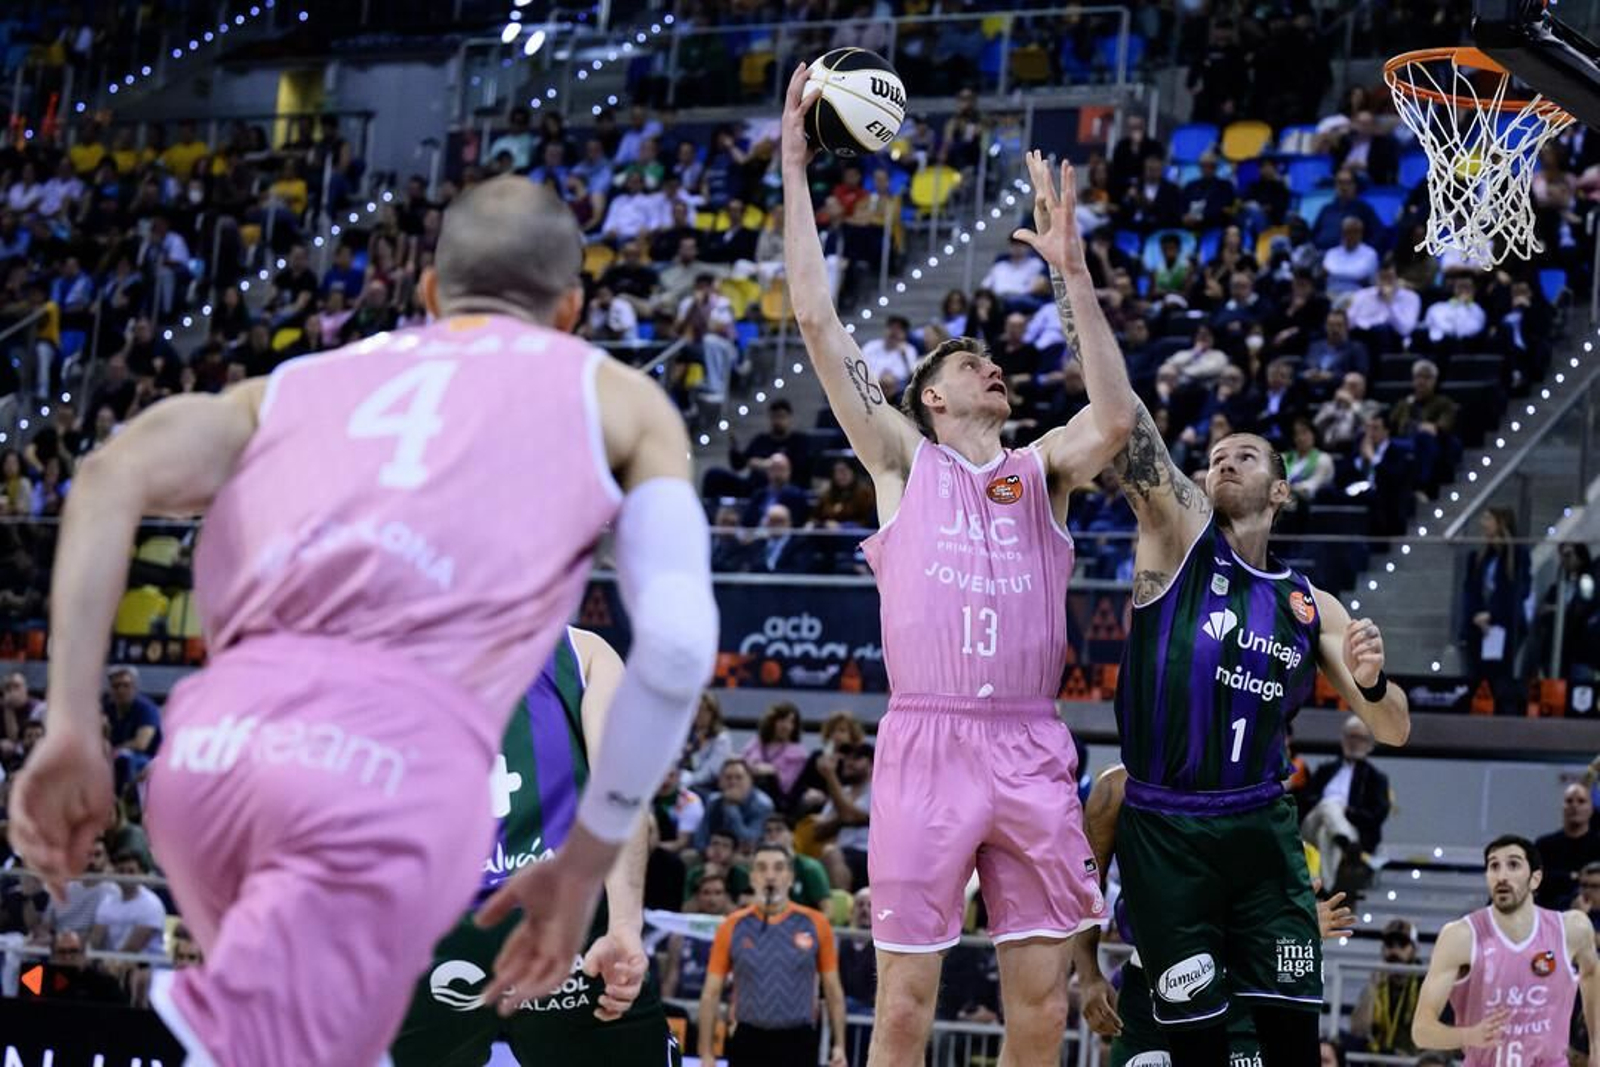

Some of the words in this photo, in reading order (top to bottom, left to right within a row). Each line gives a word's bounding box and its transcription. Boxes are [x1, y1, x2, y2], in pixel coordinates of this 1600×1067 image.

[870, 76, 906, 112] Wils
[347, 359, 458, 488] 4
[940, 509, 1018, 546] J&C
[924, 562, 1032, 596] JOVENTUT
[763, 612, 823, 641] acb
[962, 605, 998, 657] 13
[1236, 628, 1301, 669] Unicaja
[1215, 665, 1284, 701] málaga
[1230, 717, 1247, 763] 1
[1277, 953, 1314, 977] laga
[1283, 938, 1314, 959] má
[518, 993, 591, 1012] ALAGA
